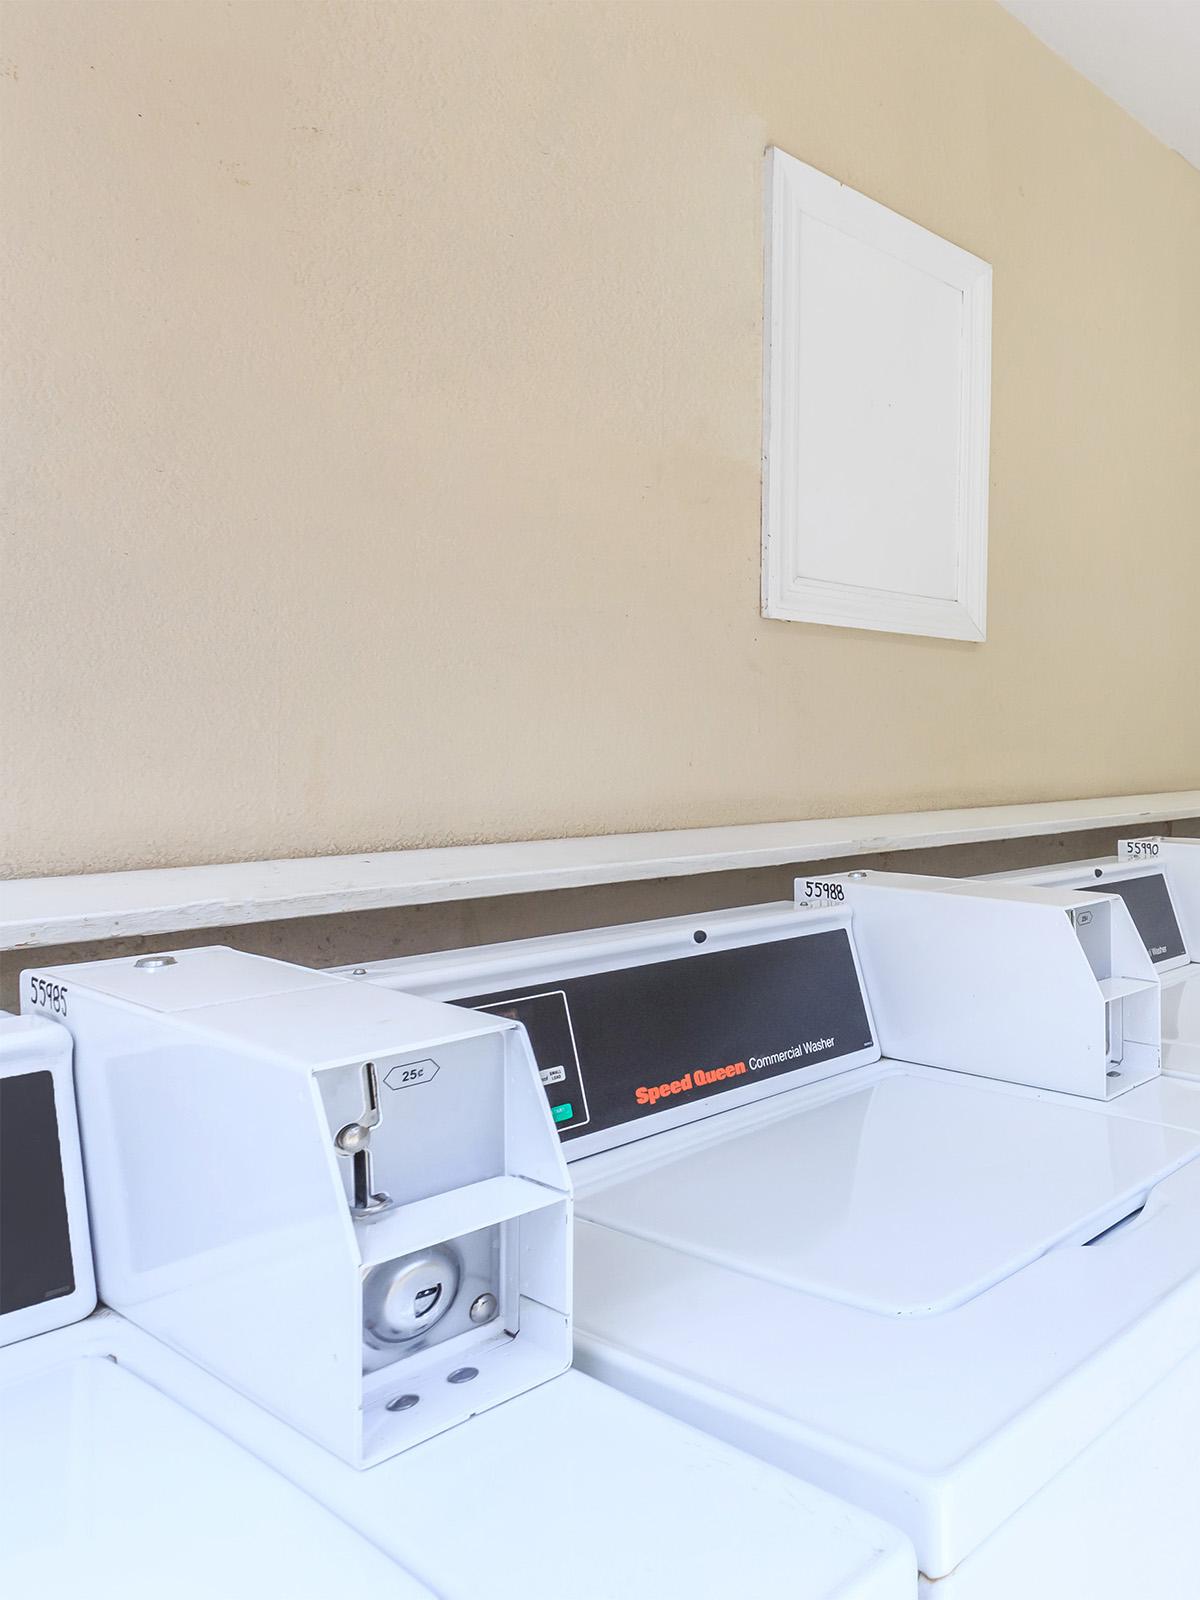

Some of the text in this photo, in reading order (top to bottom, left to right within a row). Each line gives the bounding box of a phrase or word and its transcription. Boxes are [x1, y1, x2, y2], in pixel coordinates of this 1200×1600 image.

[1127, 842, 1159, 855] 55990
[805, 881, 845, 901] 55988
[31, 976, 68, 1016] 55985
[635, 1036, 835, 1105] Speed Queen Commercial Washer
